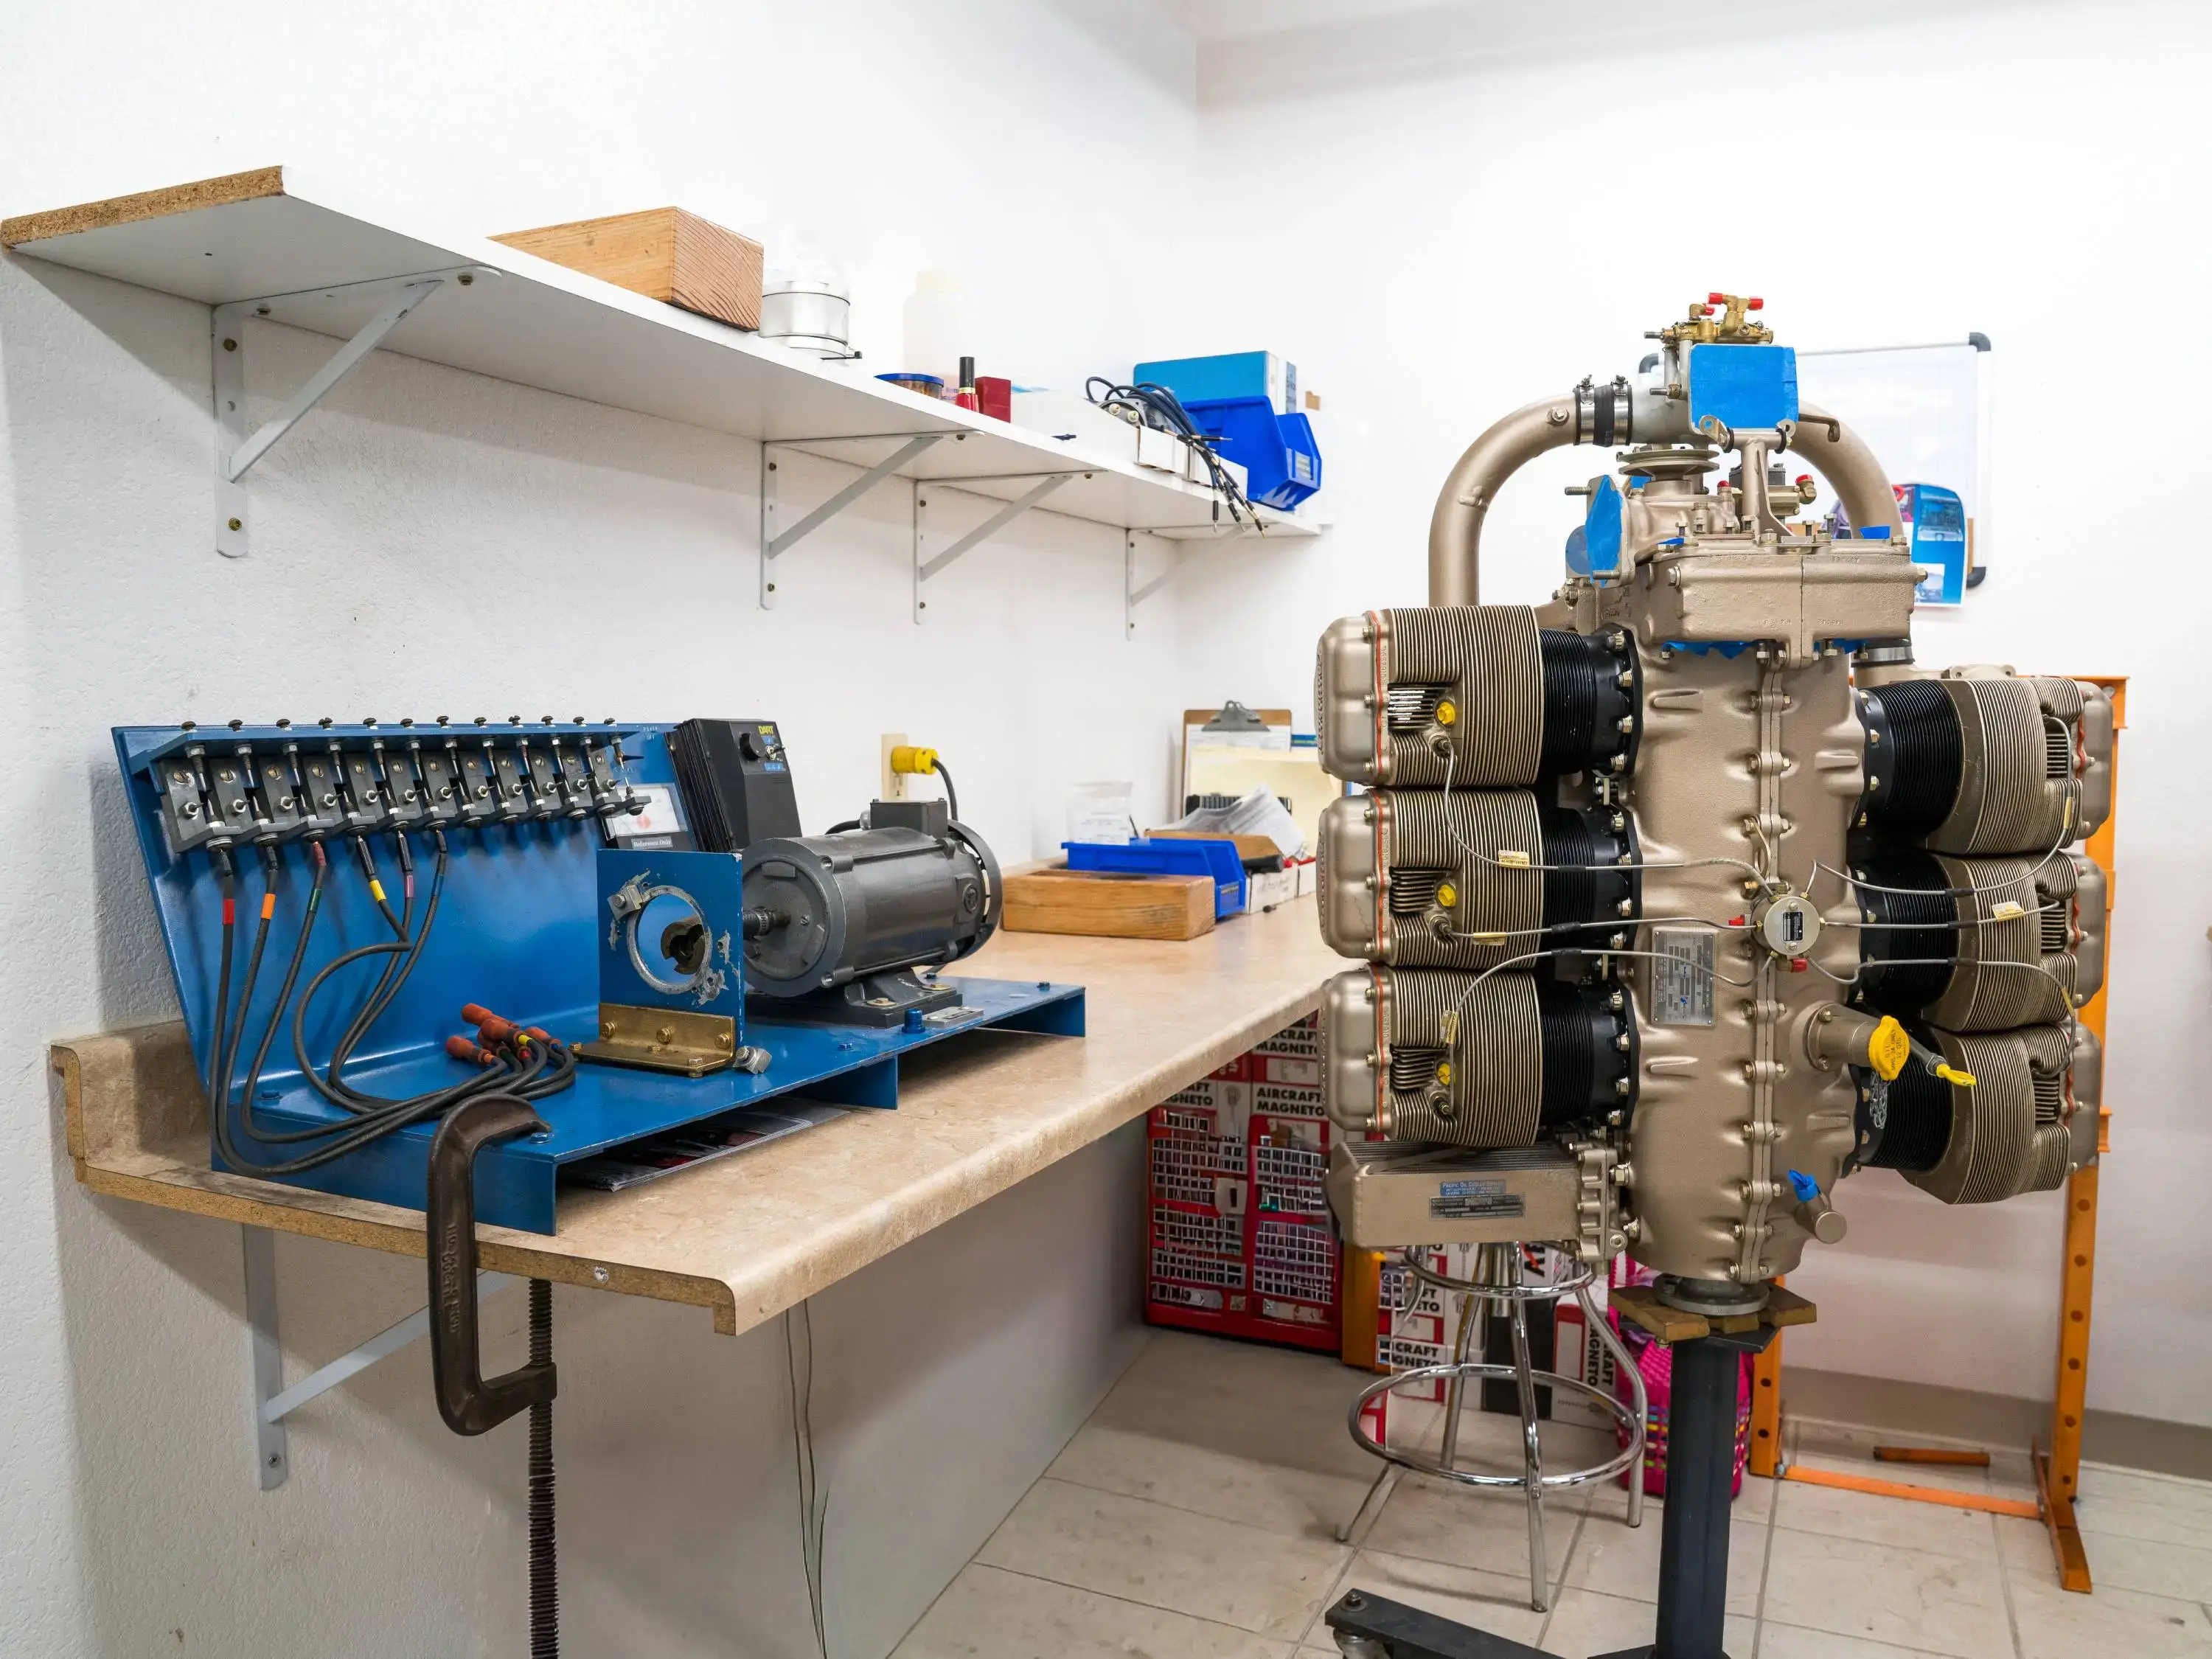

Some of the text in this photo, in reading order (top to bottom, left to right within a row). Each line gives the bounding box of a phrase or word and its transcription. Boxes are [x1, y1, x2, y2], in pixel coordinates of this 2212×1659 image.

[758, 726, 773, 734] DART
[1165, 1095, 1213, 1106] GNETO
[1256, 1087, 1321, 1103] AIRCRAFT
[1256, 1100, 1325, 1116] MAGNETO
[1393, 1341, 1439, 1357] CRAFT
[1587, 1324, 1600, 1387] AGNETO
[1392, 1354, 1440, 1370] GNET
[1602, 1342, 1614, 1386] RAFT
